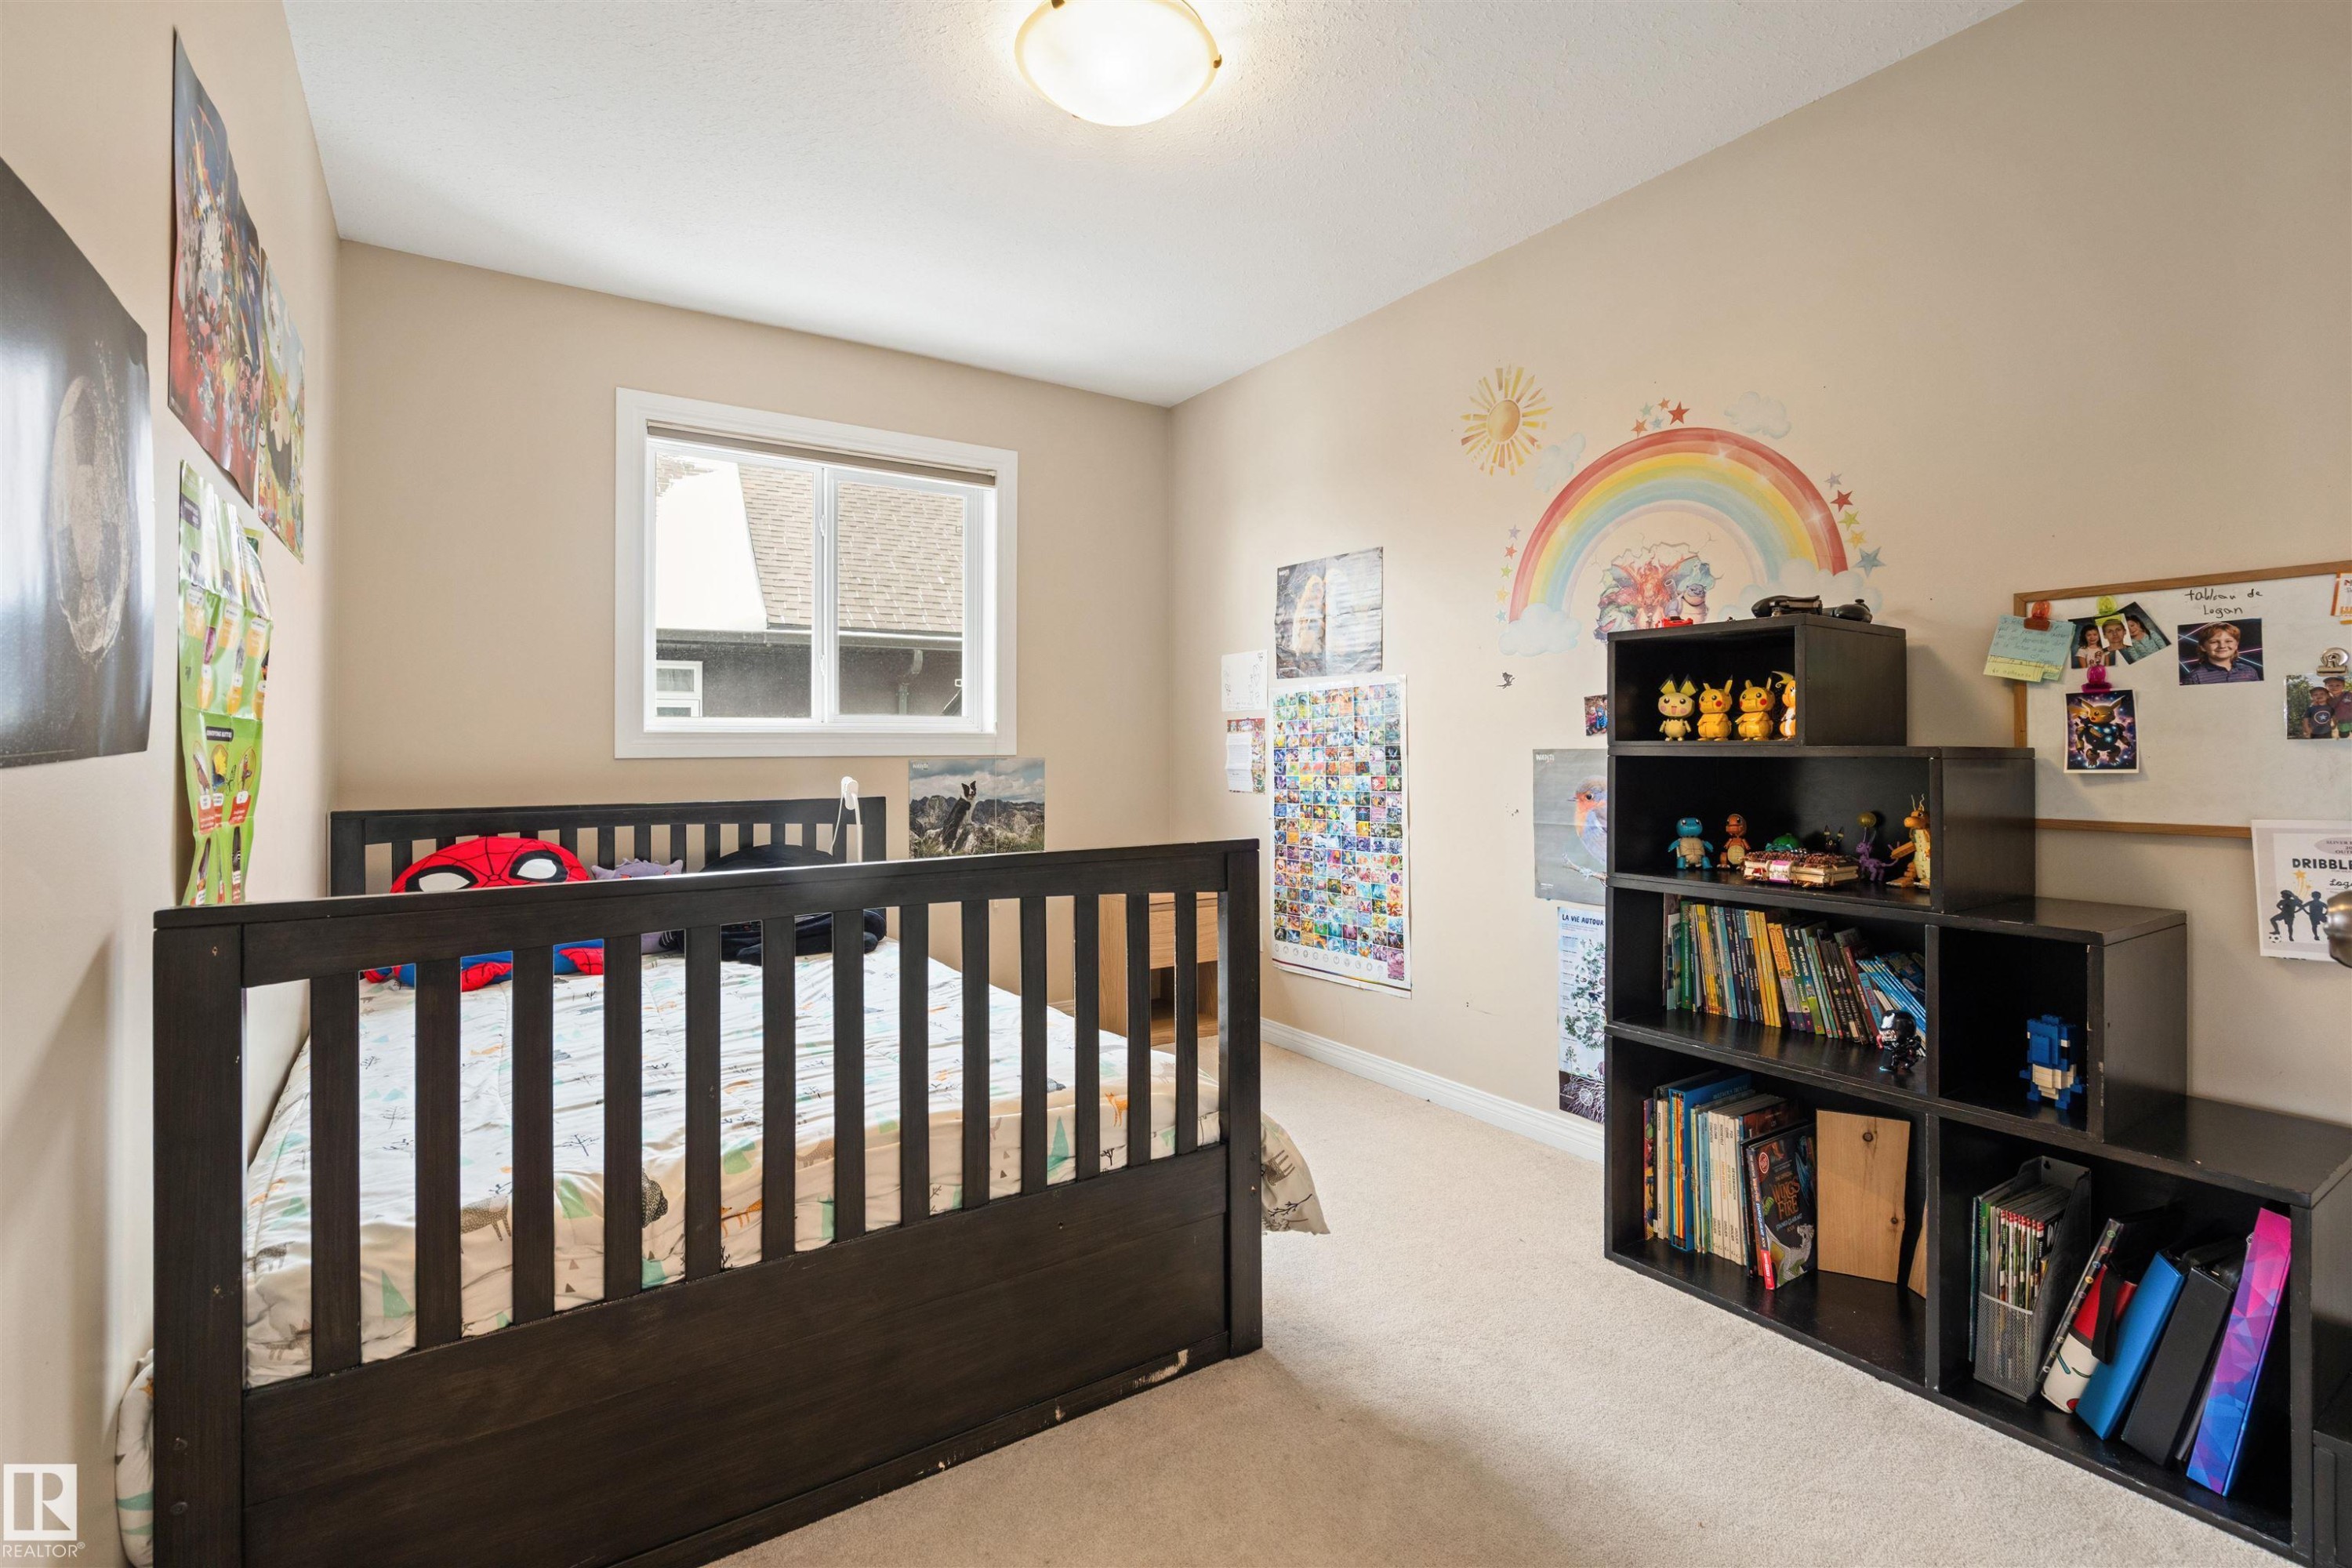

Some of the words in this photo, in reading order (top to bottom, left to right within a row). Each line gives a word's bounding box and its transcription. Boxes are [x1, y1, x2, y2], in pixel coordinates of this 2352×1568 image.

[2184, 588, 2236, 601] tableau
[2247, 588, 2263, 597] de
[2203, 604, 2243, 619] Logan
[1581, 916, 1604, 926] AUTOUR
[1769, 1178, 1800, 1203] WINGS
[1777, 1196, 1800, 1221] FIRE
